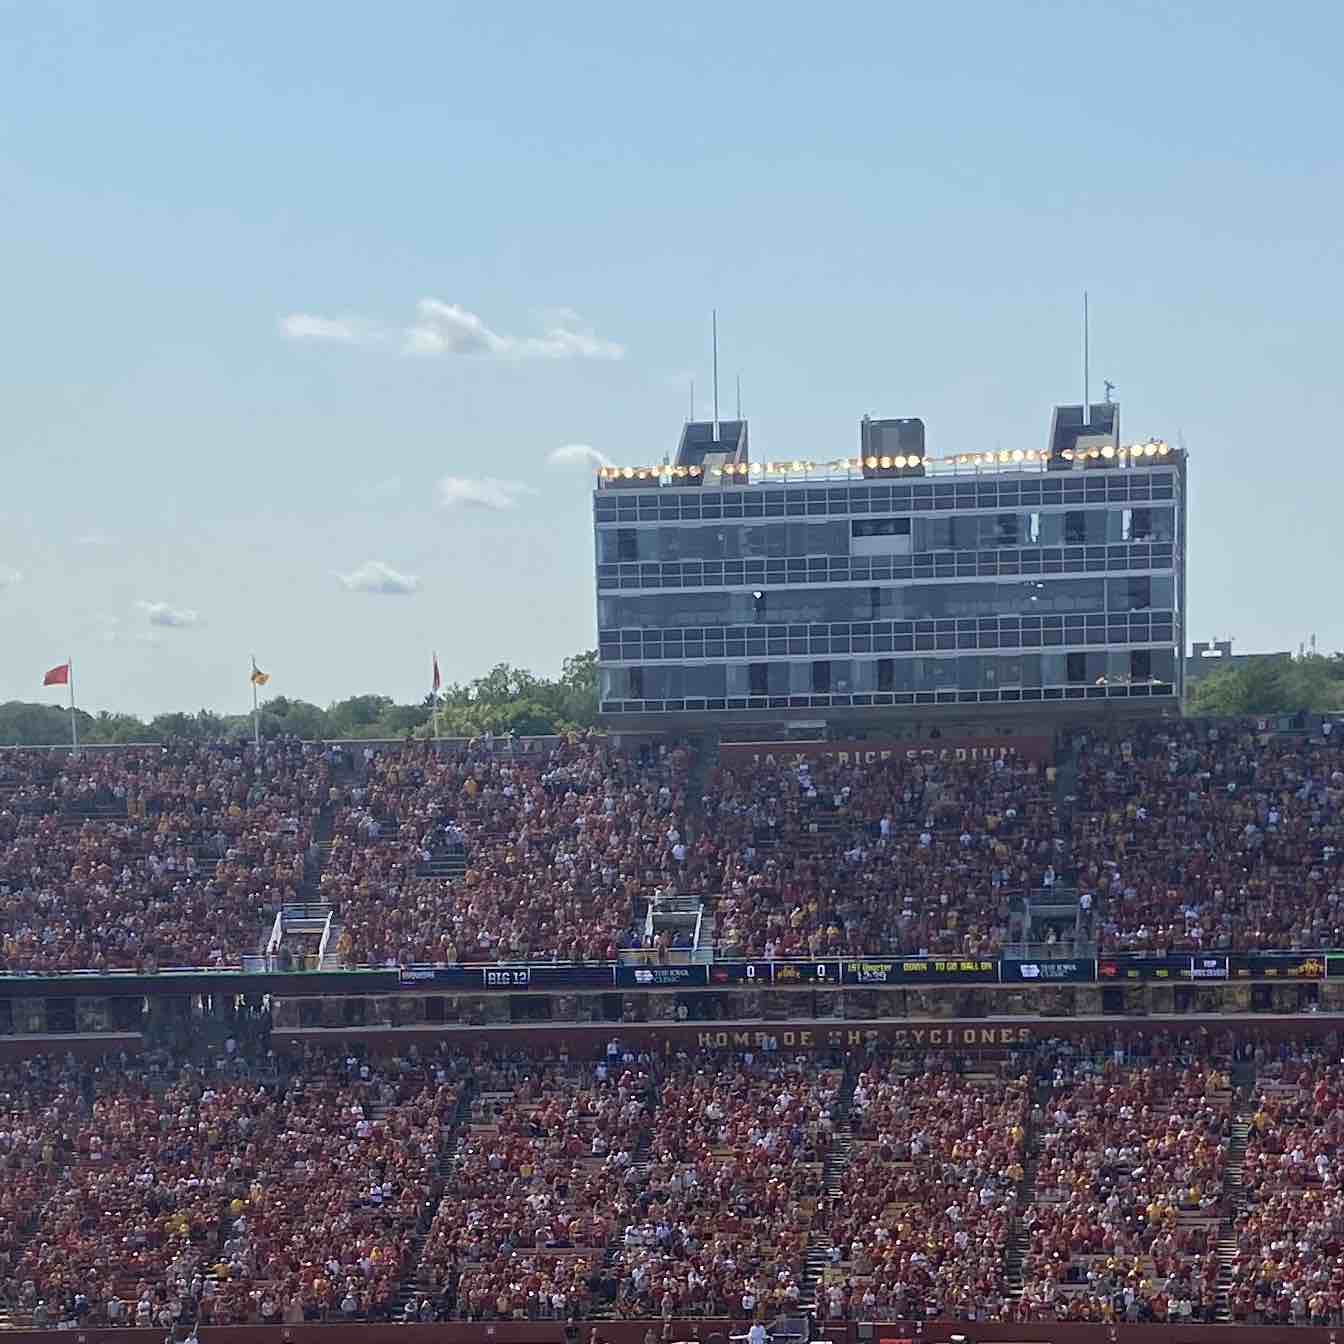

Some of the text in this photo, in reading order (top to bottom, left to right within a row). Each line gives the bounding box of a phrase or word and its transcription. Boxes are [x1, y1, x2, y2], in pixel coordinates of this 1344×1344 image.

[746, 965, 755, 978] 0
[816, 964, 825, 977] 0
[487, 971, 528, 985] BIG 12
